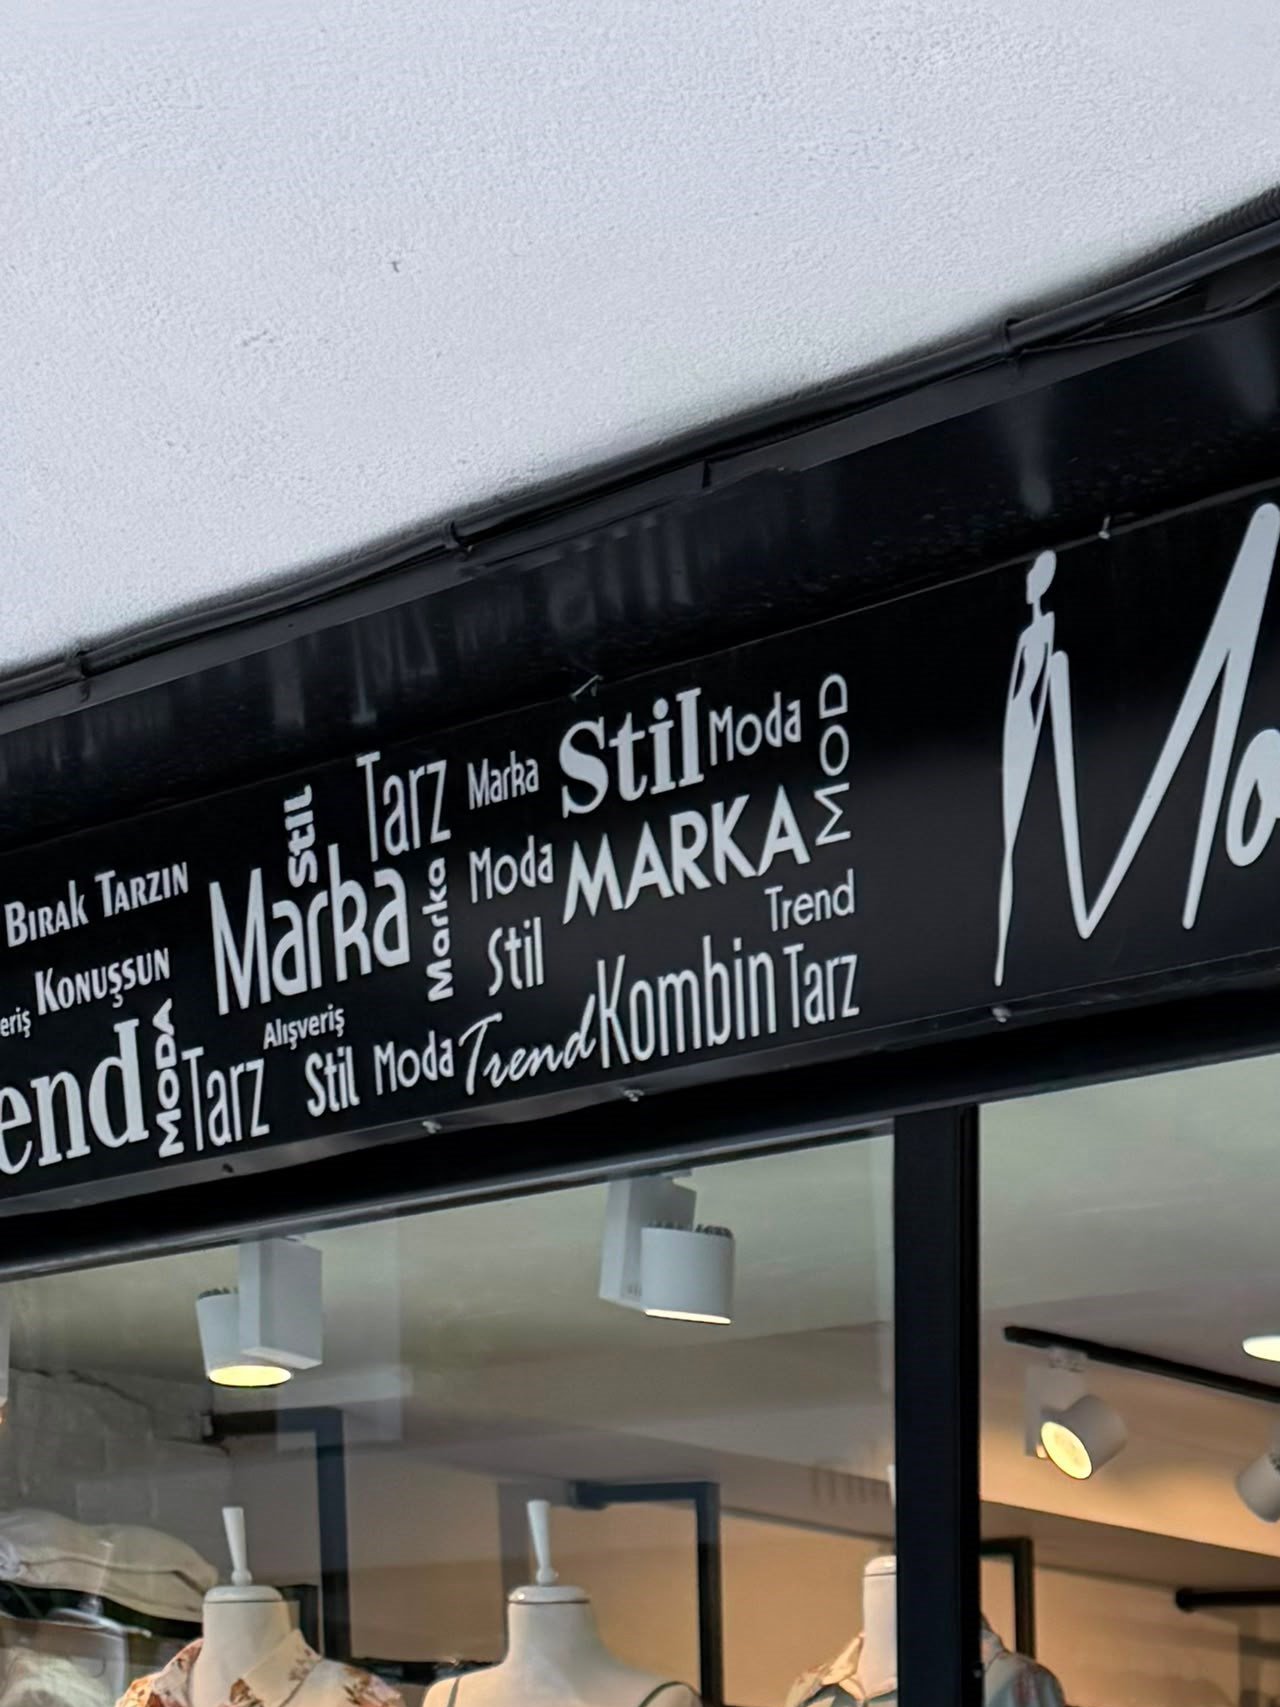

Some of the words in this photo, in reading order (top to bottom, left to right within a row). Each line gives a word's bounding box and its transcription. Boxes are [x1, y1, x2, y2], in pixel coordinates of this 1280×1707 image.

[559, 687, 703, 817] Stil
[709, 692, 800, 765] Moda
[814, 674, 850, 845] MOD
[356, 751, 450, 861] Tarz
[468, 750, 538, 809] Marka
[469, 835, 553, 903] Moda
[562, 786, 812, 925] MARKA
[764, 868, 854, 931] Trend
[209, 843, 409, 1014] Marka
[422, 857, 453, 1001] Marka
[487, 916, 543, 995] Stil
[263, 1004, 344, 1049] Alışveriş
[597, 934, 776, 1068] Kombin
[782, 943, 859, 1027] Tarz
[152, 998, 184, 1157] MODA
[305, 1046, 359, 1116] Stil
[373, 1030, 453, 1094] Moda
[458, 994, 596, 1094] Trend
[181, 1046, 269, 1150] Tarz
